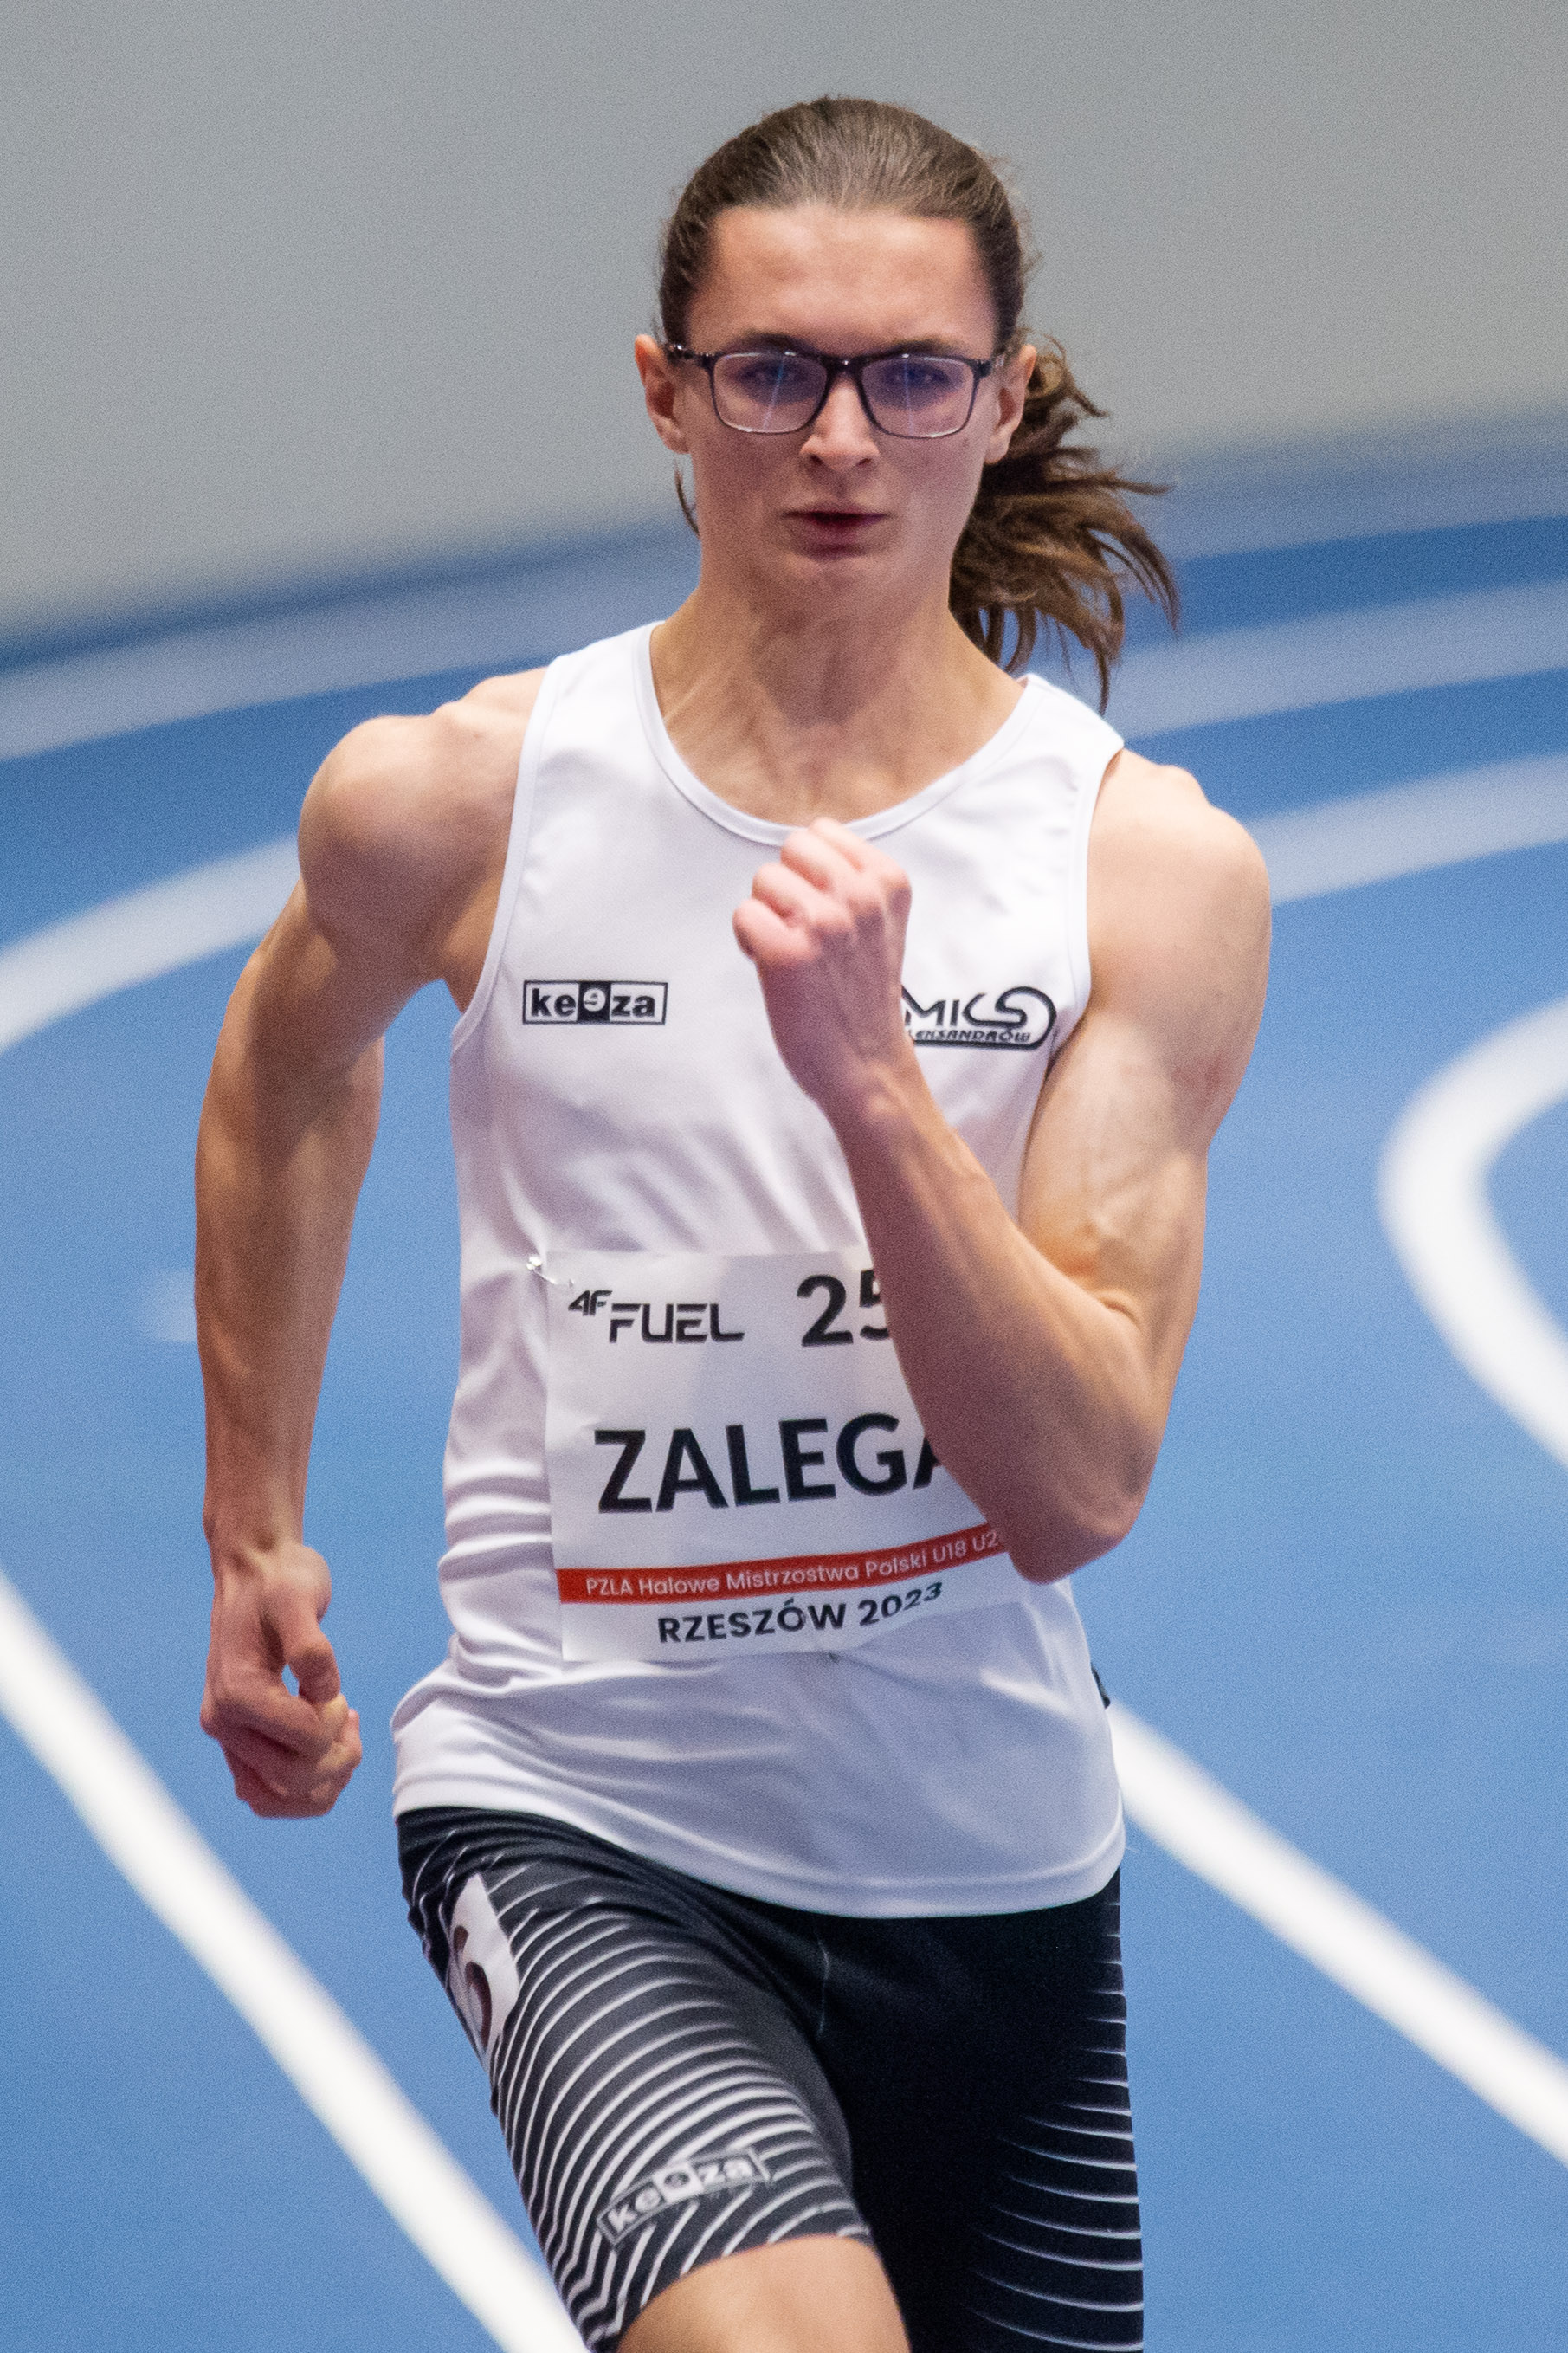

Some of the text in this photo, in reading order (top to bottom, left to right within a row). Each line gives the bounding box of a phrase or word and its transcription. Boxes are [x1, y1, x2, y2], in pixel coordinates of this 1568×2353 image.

[567, 1290, 745, 1344] 4F FUEL
[586, 1577, 634, 1597] PZLA
[639, 1576, 719, 1597] Halowe
[726, 1565, 859, 1589] Mistrzostwa
[866, 1549, 926, 1577] Polski
[932, 1540, 967, 1562] U18
[657, 1581, 942, 1643] RZESZÓW 2023
